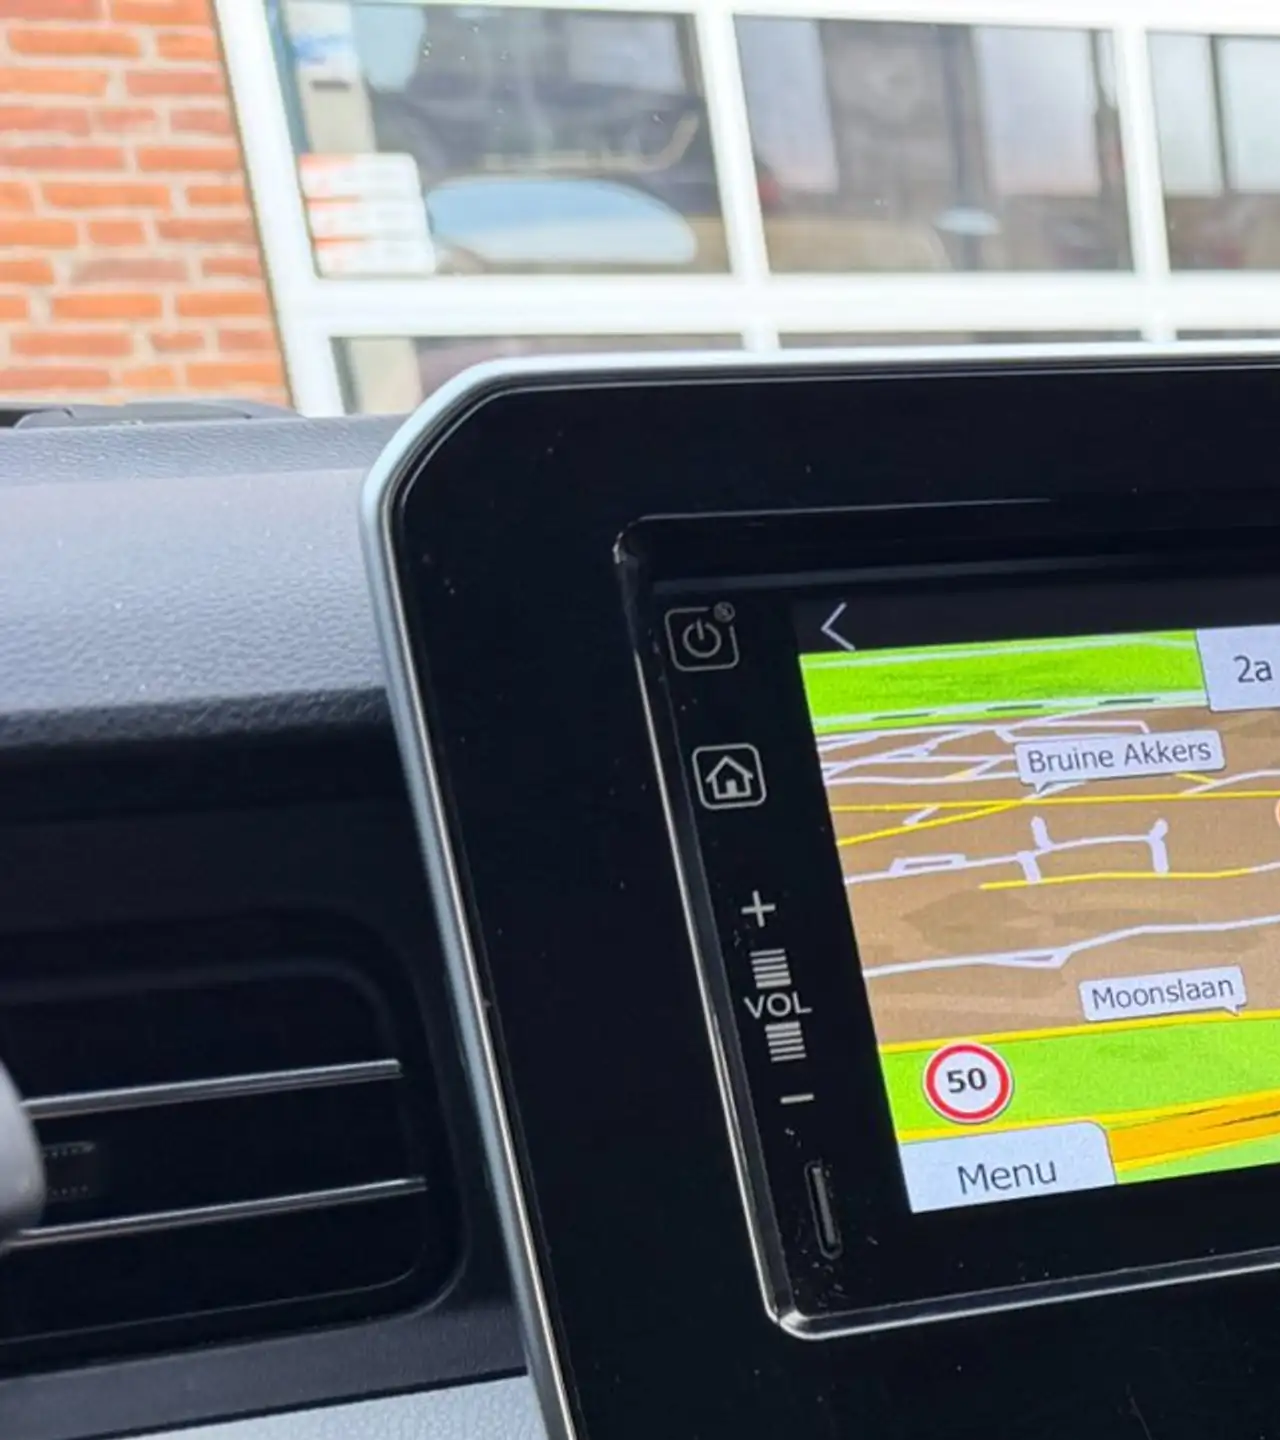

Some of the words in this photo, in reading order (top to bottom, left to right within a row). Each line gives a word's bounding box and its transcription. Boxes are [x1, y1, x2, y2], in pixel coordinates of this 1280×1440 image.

[1233, 655, 1273, 685] 2a
[1028, 744, 1114, 775] Bruine
[1125, 738, 1212, 768] Akkers
[744, 992, 812, 1020] VOL
[1092, 975, 1235, 1012] Moonslaan
[946, 1068, 986, 1094] 50
[957, 1158, 1058, 1196] Menu
